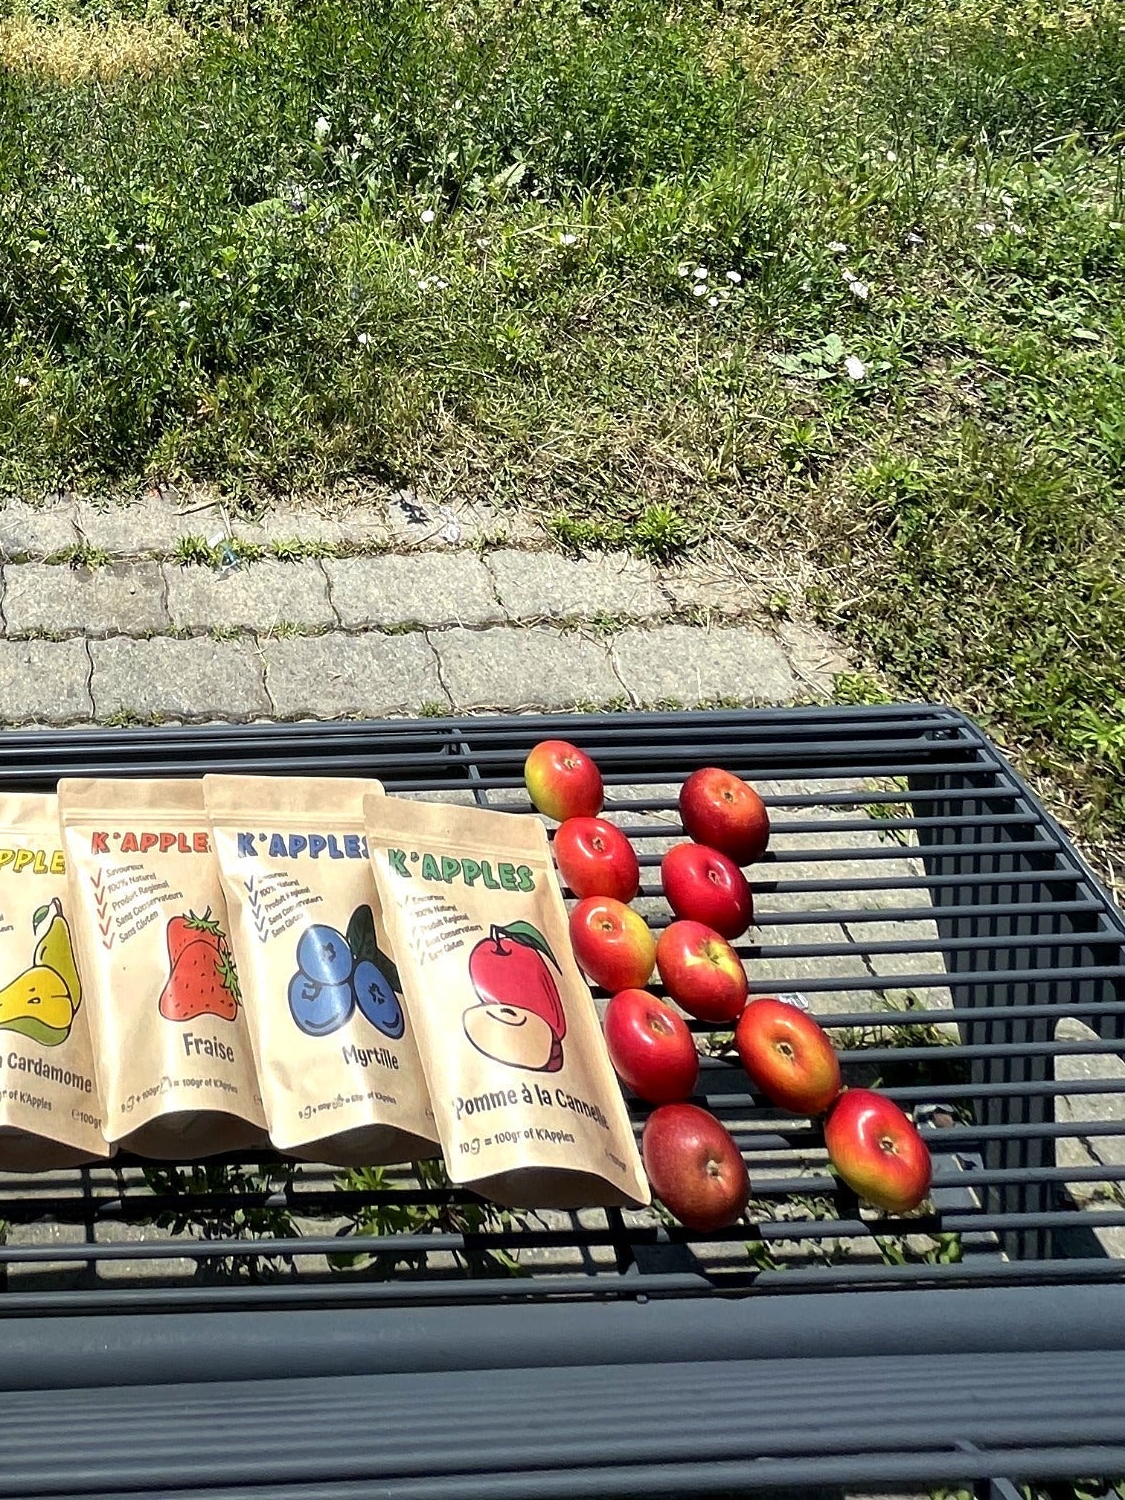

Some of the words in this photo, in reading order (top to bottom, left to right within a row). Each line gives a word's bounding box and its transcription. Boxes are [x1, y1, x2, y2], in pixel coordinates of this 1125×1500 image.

[91, 831, 212, 855] K'APPLE
[387, 849, 536, 892] K'APPLES
[182, 1032, 235, 1063] Fraise
[342, 1044, 399, 1070] Myrtille
[7, 1052, 92, 1094] Cardamome
[182, 1078, 203, 1088] 100gr
[205, 1078, 212, 1087] of
[8, 1089, 18, 1100] of
[19, 1091, 52, 1111] K'Apples
[453, 1089, 518, 1120] Pomme
[521, 1082, 533, 1104] à
[534, 1083, 552, 1106] la
[556, 1088, 610, 1130] Cannelle
[459, 1143, 469, 1154] 10
[494, 1130, 520, 1144] 100gr
[524, 1128, 534, 1139] of
[536, 1128, 575, 1144] K'Apples
